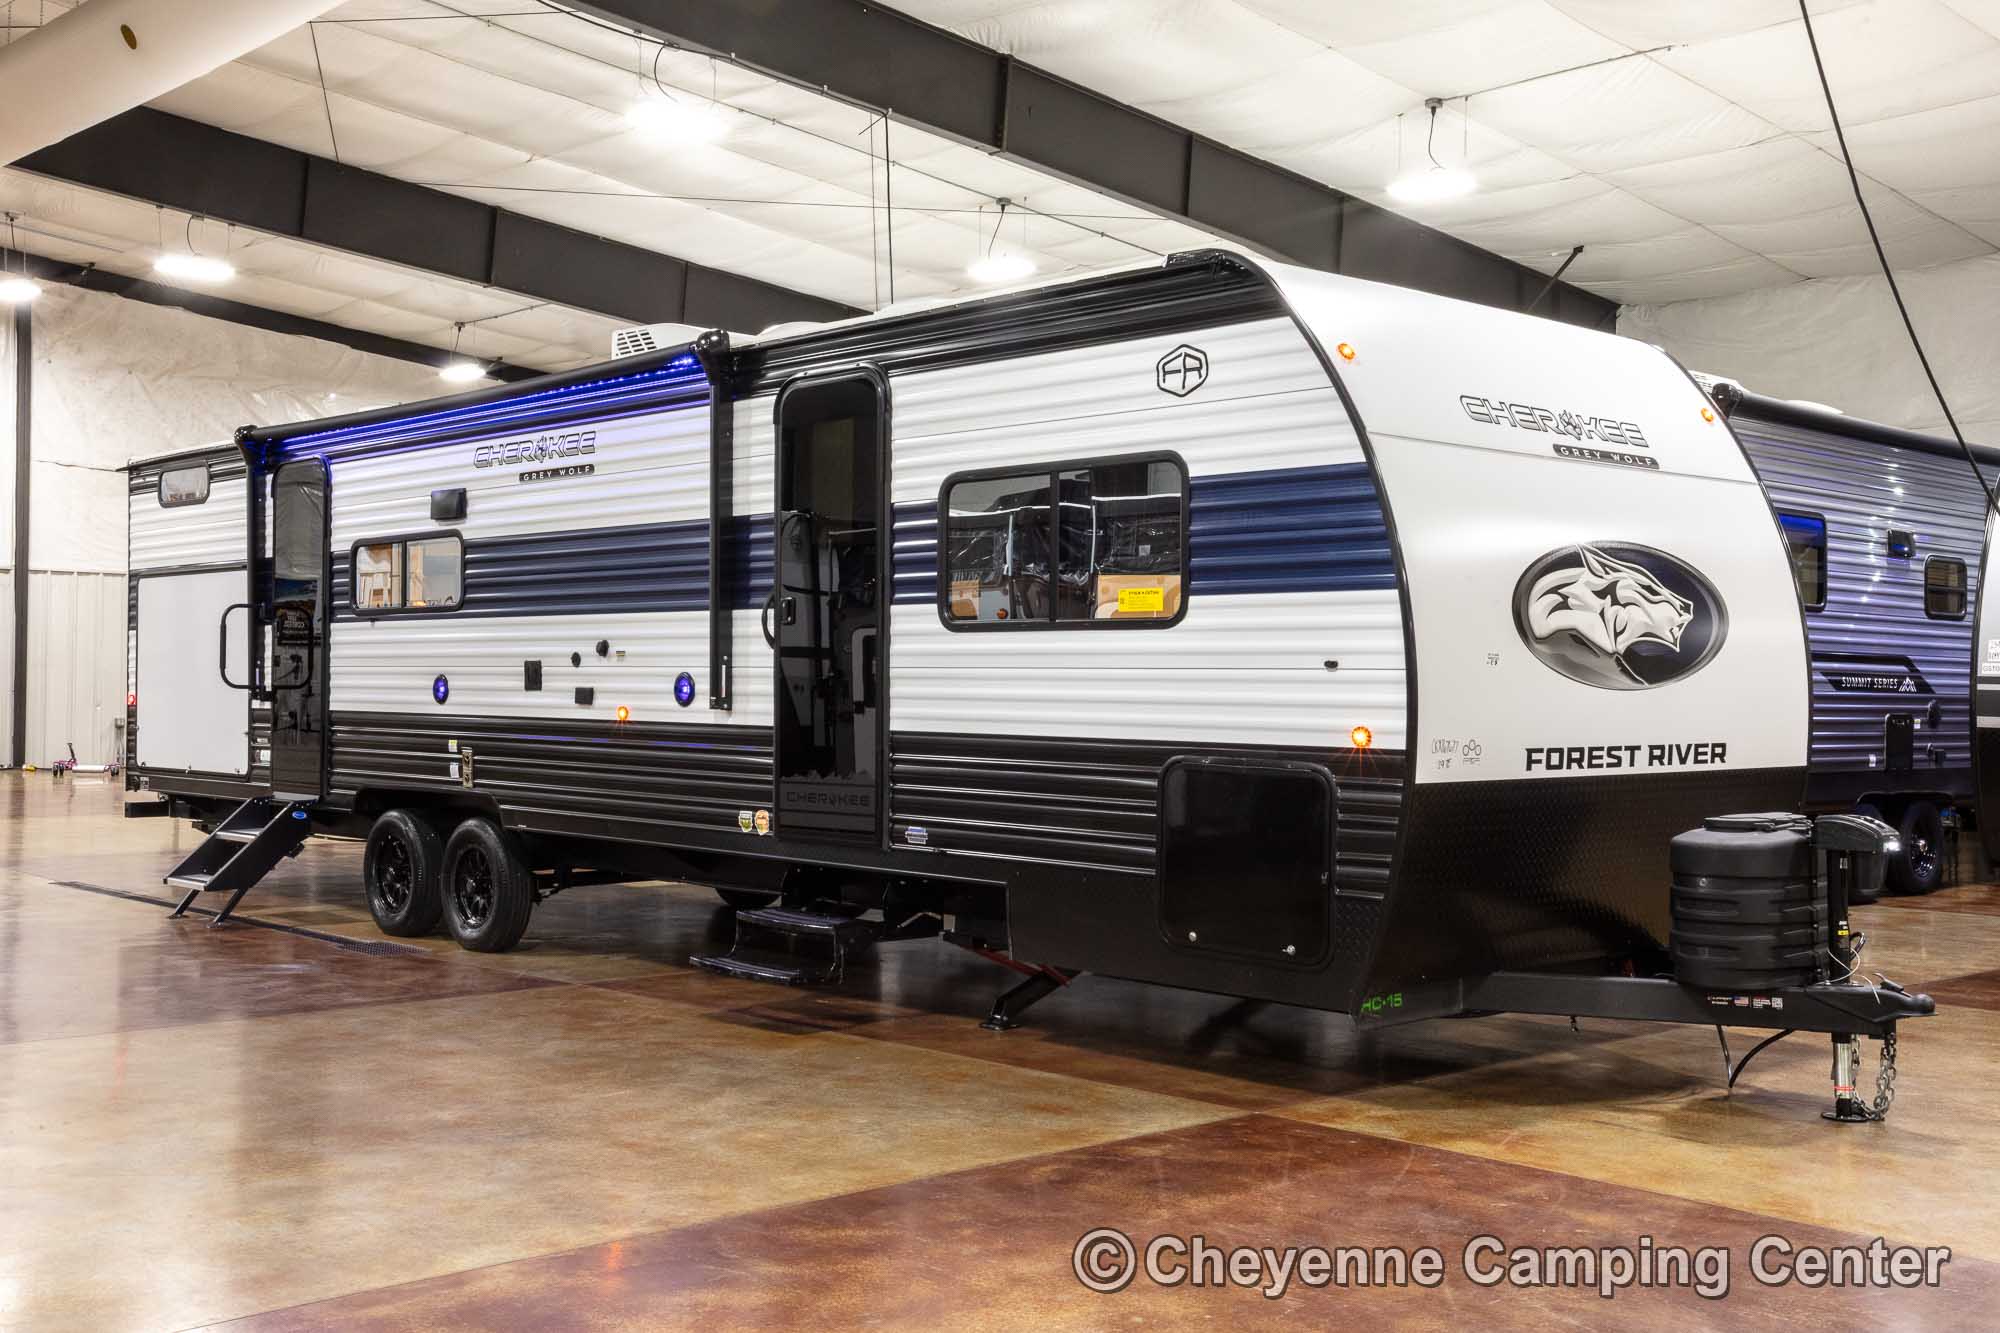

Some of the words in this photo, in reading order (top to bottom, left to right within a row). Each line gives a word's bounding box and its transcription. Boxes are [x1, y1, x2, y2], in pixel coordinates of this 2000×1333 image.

[1560, 447, 1601, 460] GREY
[1612, 454, 1652, 466] WOLF
[523, 471, 552, 481] GREY
[559, 465, 590, 476] WOLF
[1841, 676, 1872, 688] SUMMIT
[1873, 678, 1898, 689] SERIES
[1525, 745, 1642, 772] FOREST
[1647, 743, 1727, 767] RIVER
